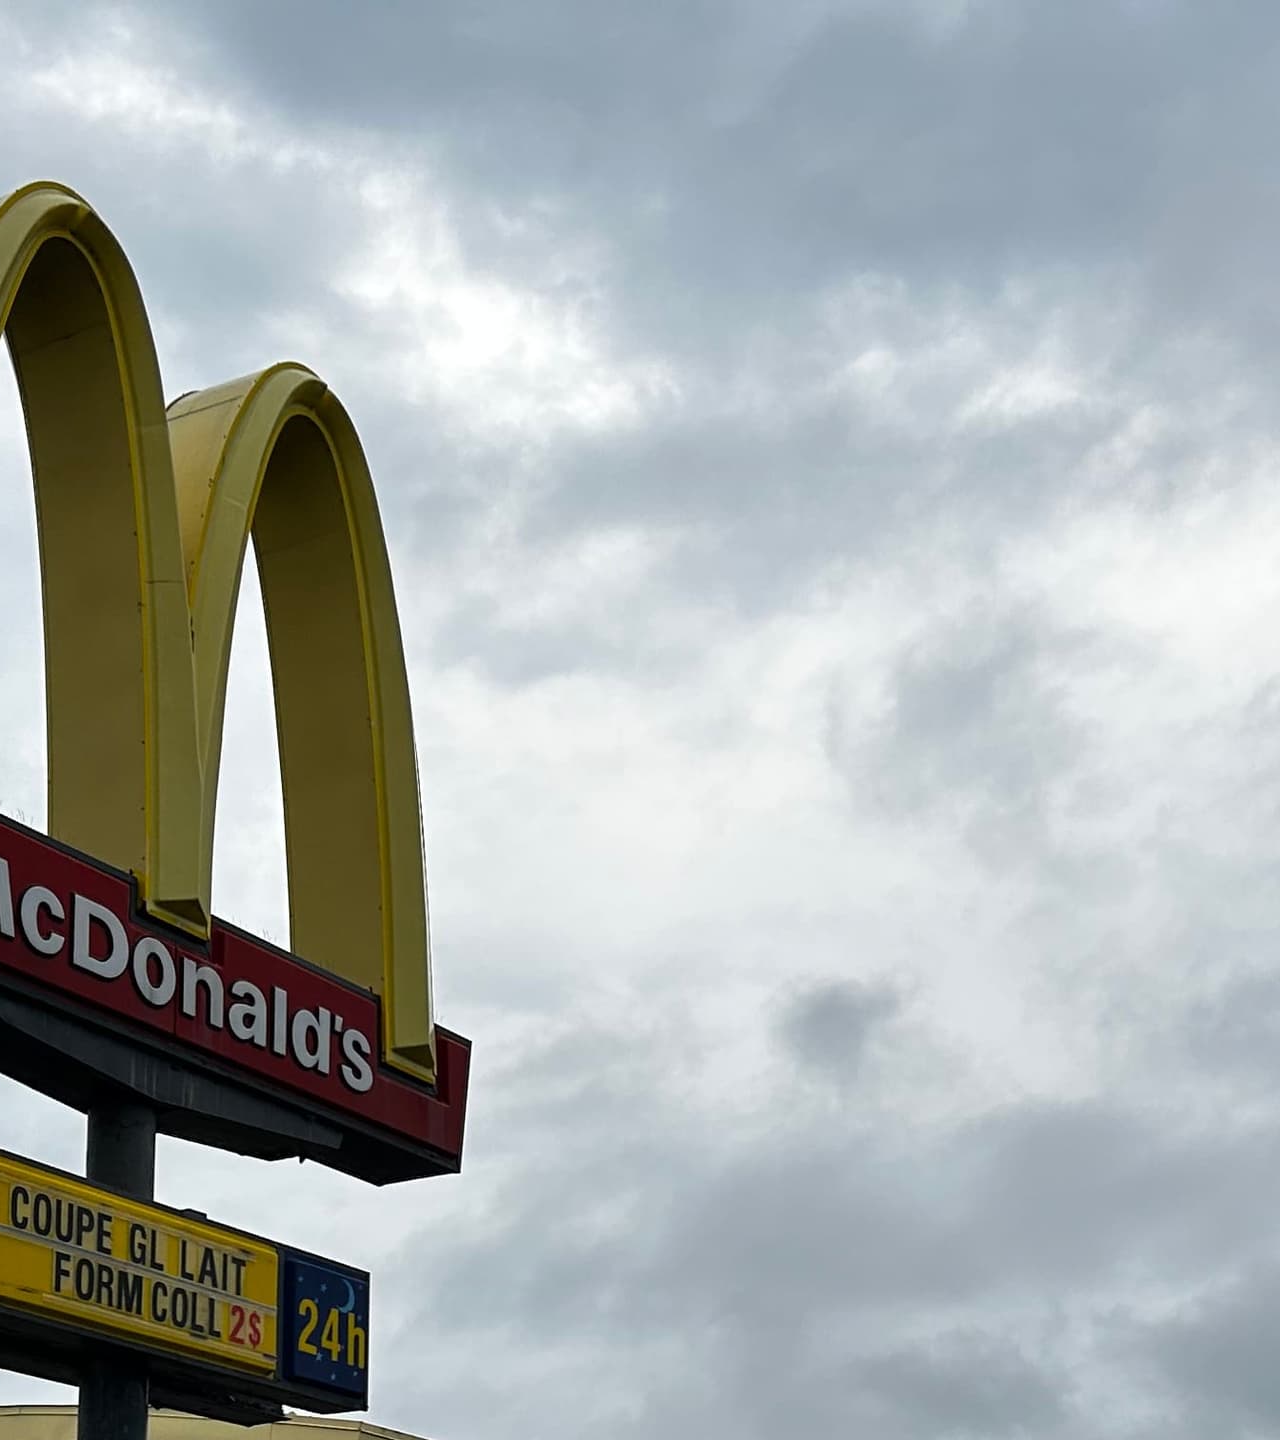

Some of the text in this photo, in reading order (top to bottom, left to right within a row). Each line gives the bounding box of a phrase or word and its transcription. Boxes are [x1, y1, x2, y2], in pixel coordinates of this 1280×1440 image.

[9, 1184, 248, 1298] COUPE GL LAIT
[52, 1250, 263, 1350] FORM COLL 2$
[297, 1298, 366, 1370] 24h
